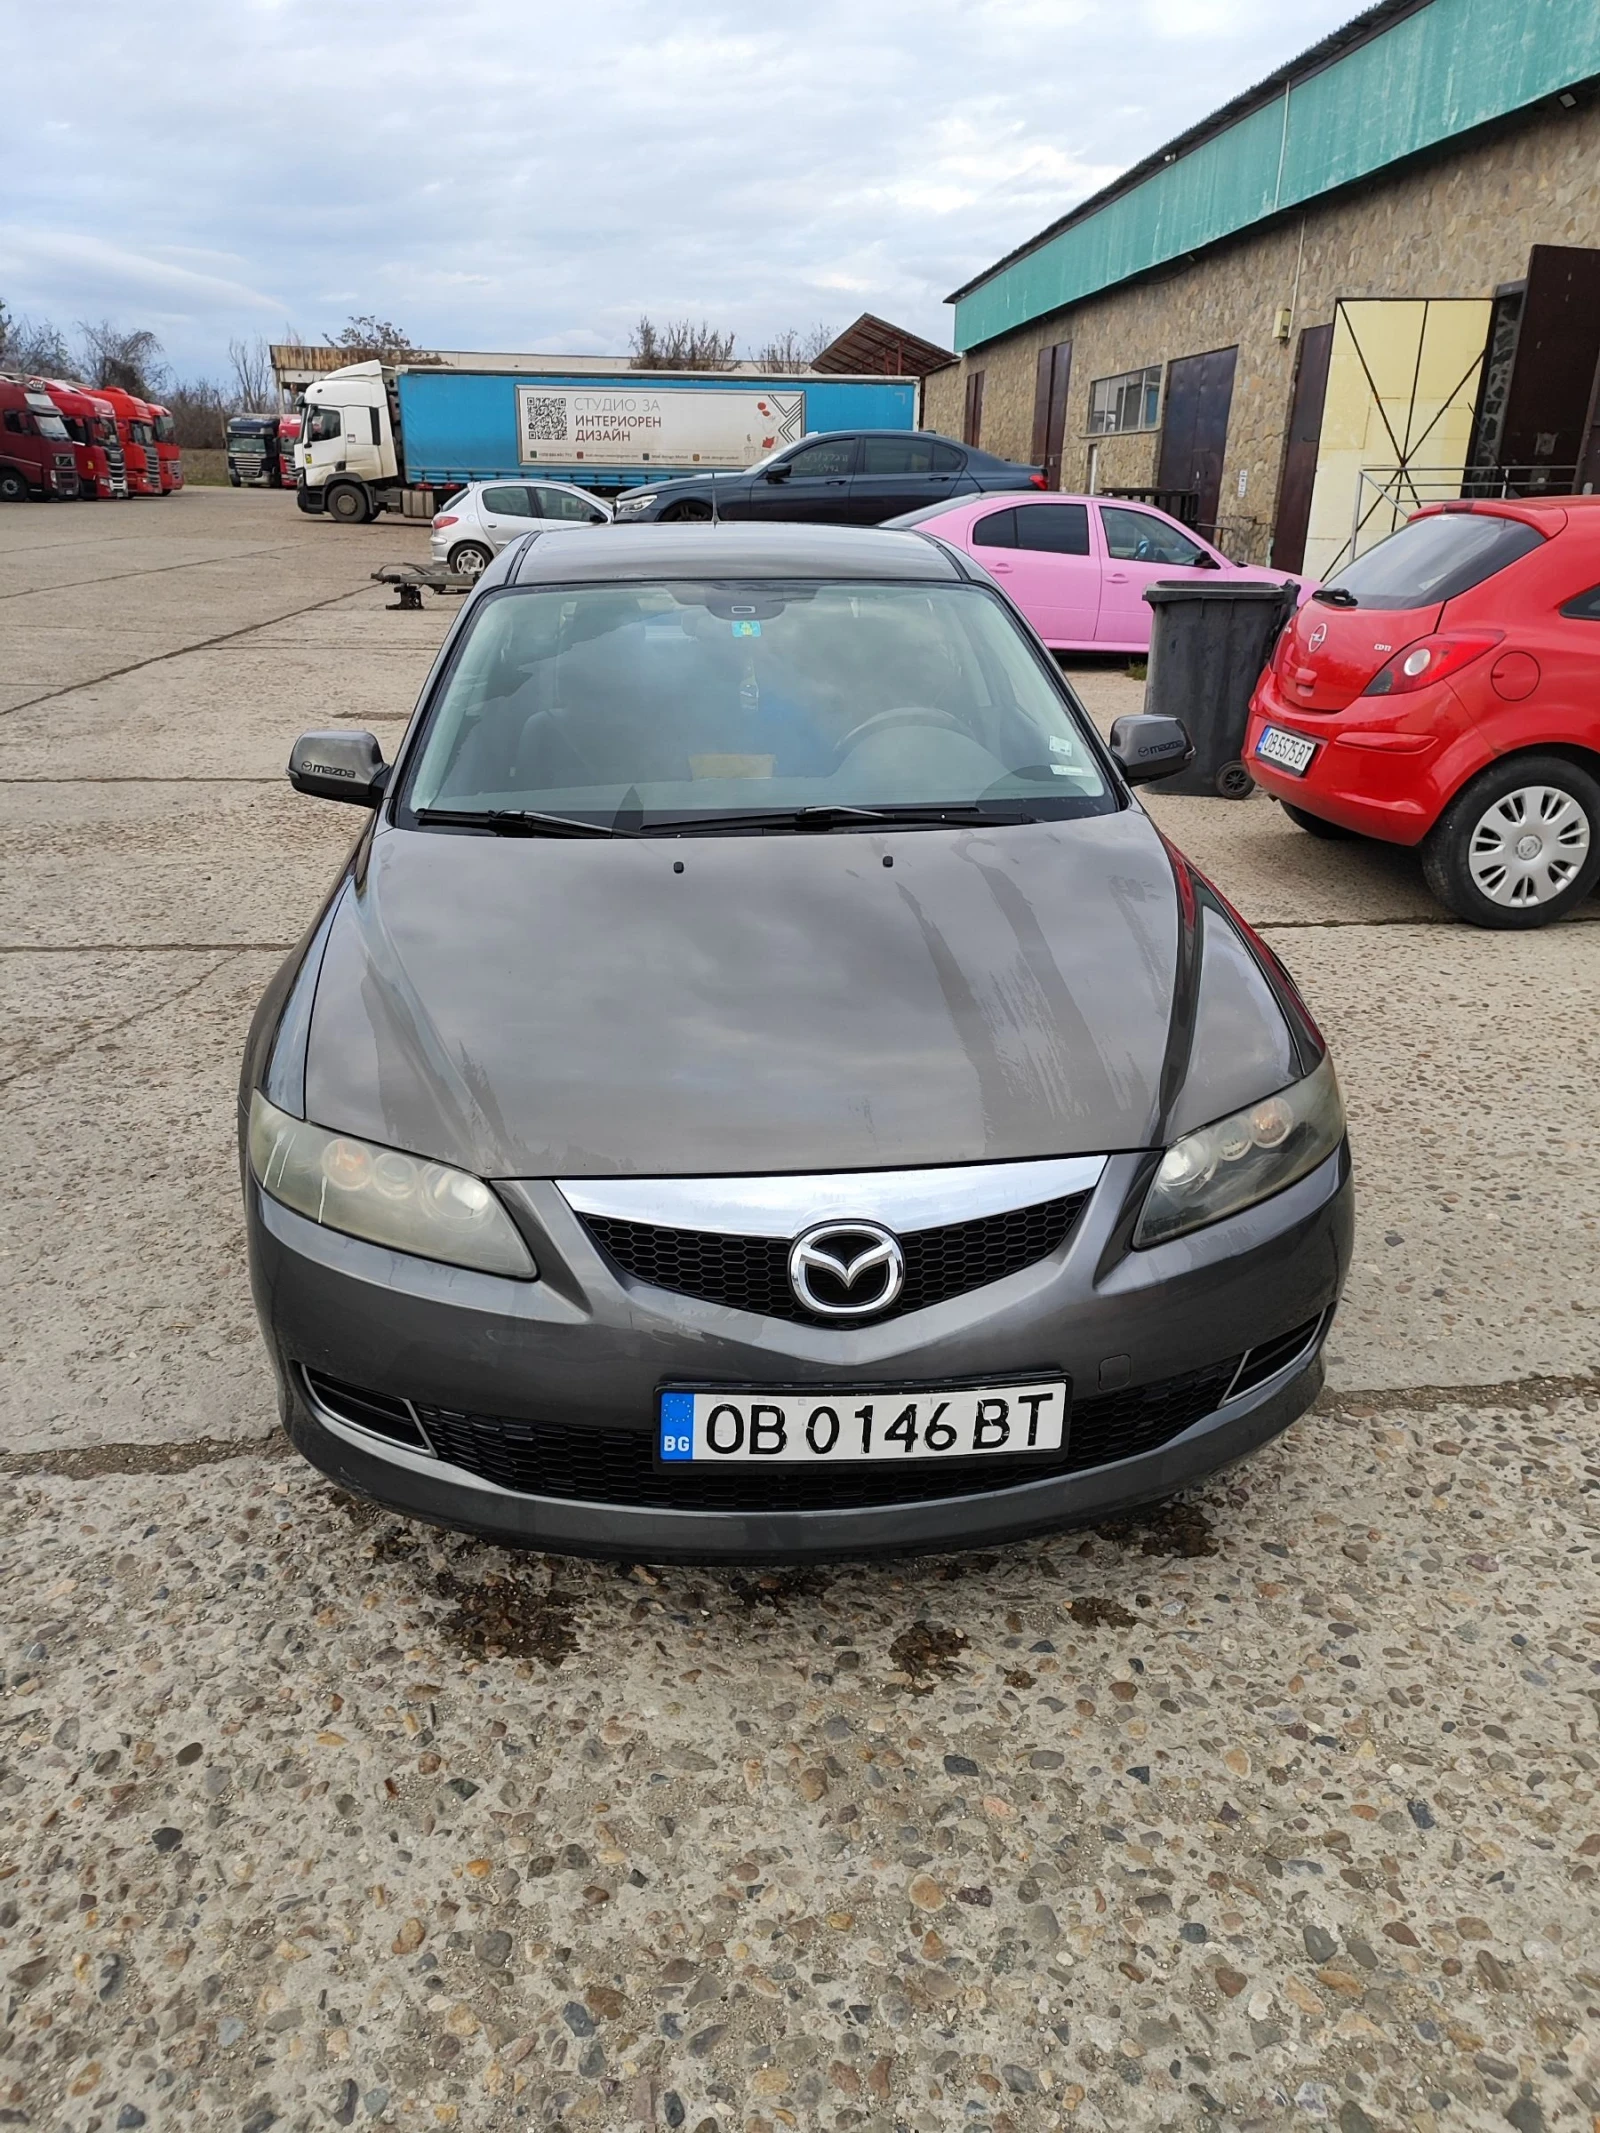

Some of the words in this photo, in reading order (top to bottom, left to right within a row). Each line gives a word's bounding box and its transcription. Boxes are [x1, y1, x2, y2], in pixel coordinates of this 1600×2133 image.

[574, 397, 637, 412] СТУДИО
[642, 399, 661, 412] ЗА
[575, 415, 662, 428] ИНТЕРИОРЕН
[575, 428, 631, 442] ДИЗАЙН
[313, 764, 356, 779] mazda
[663, 1436, 690, 1452] BG
